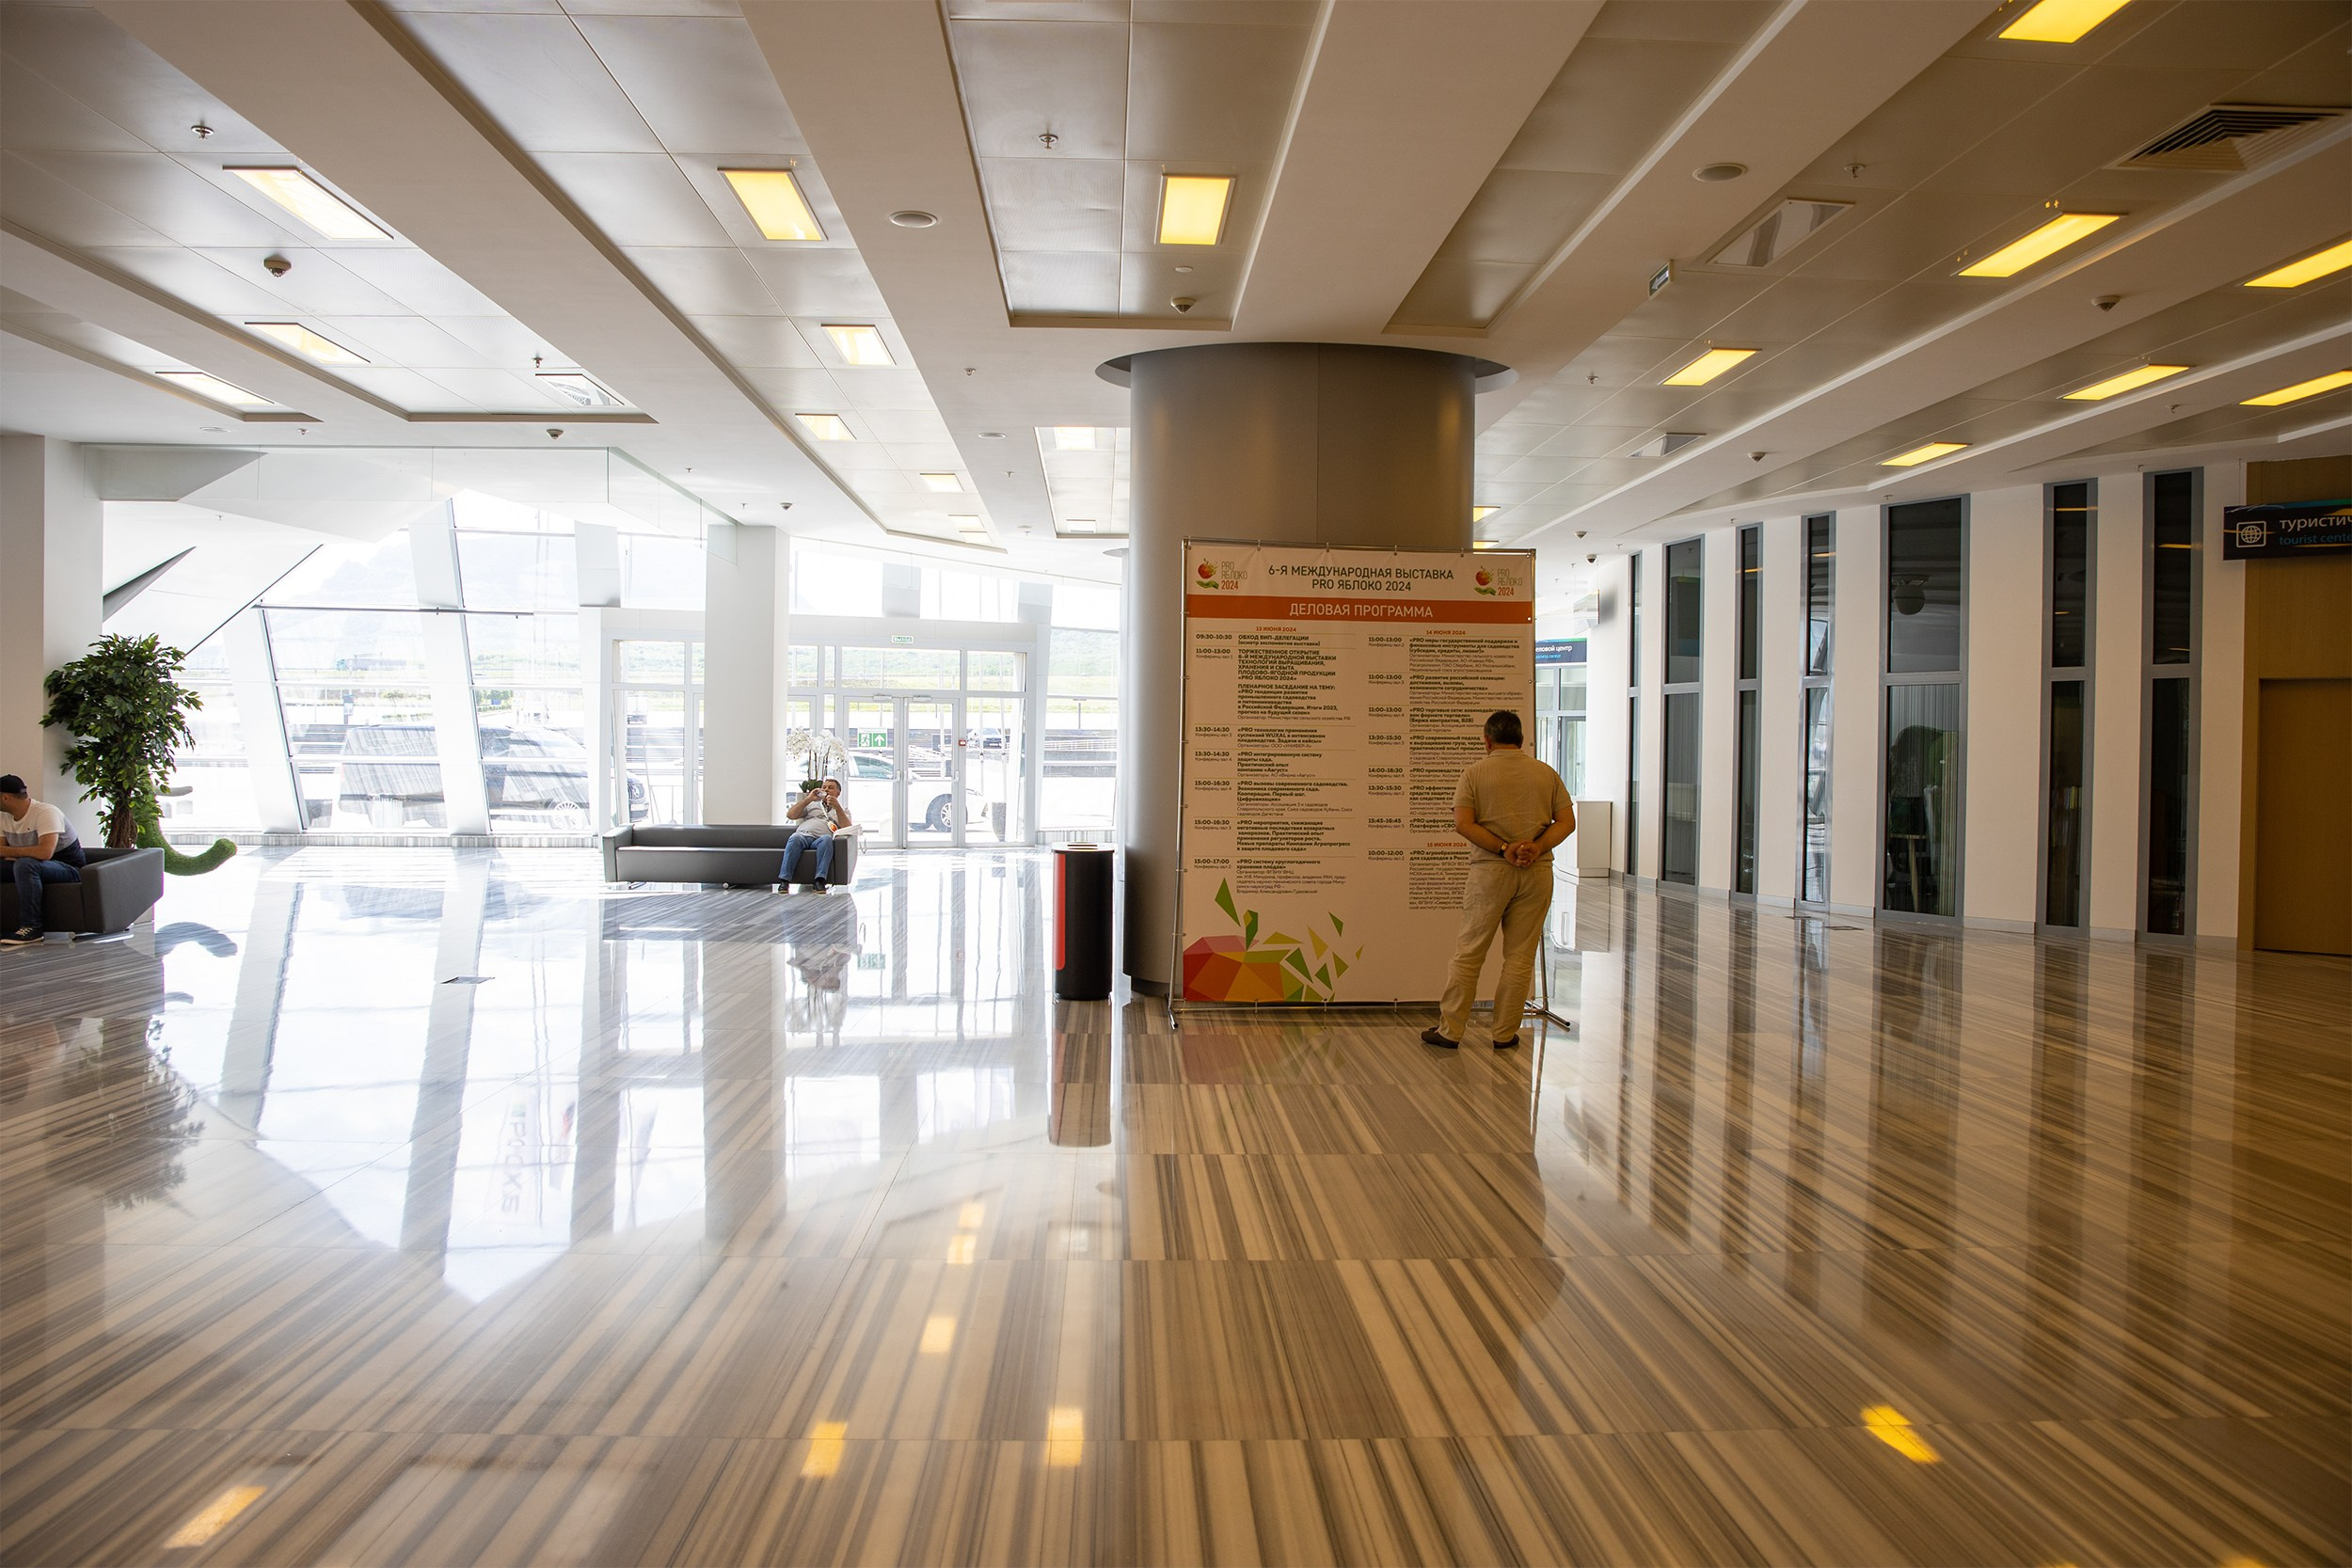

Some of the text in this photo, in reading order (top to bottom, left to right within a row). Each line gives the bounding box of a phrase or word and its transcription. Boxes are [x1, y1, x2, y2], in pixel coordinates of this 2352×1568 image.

[2280, 534, 2318, 545] tourist
[1221, 561, 1234, 570] PRO
[1221, 570, 1248, 580] ЯБЛОКО
[1268, 565, 1454, 579] 6-Я МЕЖДУНАРОДНАЯ ВЫСТАВКА
[1497, 569, 1510, 578] PRO
[1221, 580, 1239, 590] 2024
[1312, 579, 1412, 591] PRO ЯБЛОКО 2024
[1497, 577, 1523, 586] ЯБЛОКО
[1497, 586, 1514, 596] 2024
[1289, 603, 1433, 618] ДЕЛОВАЯ ПРОГРАММА
